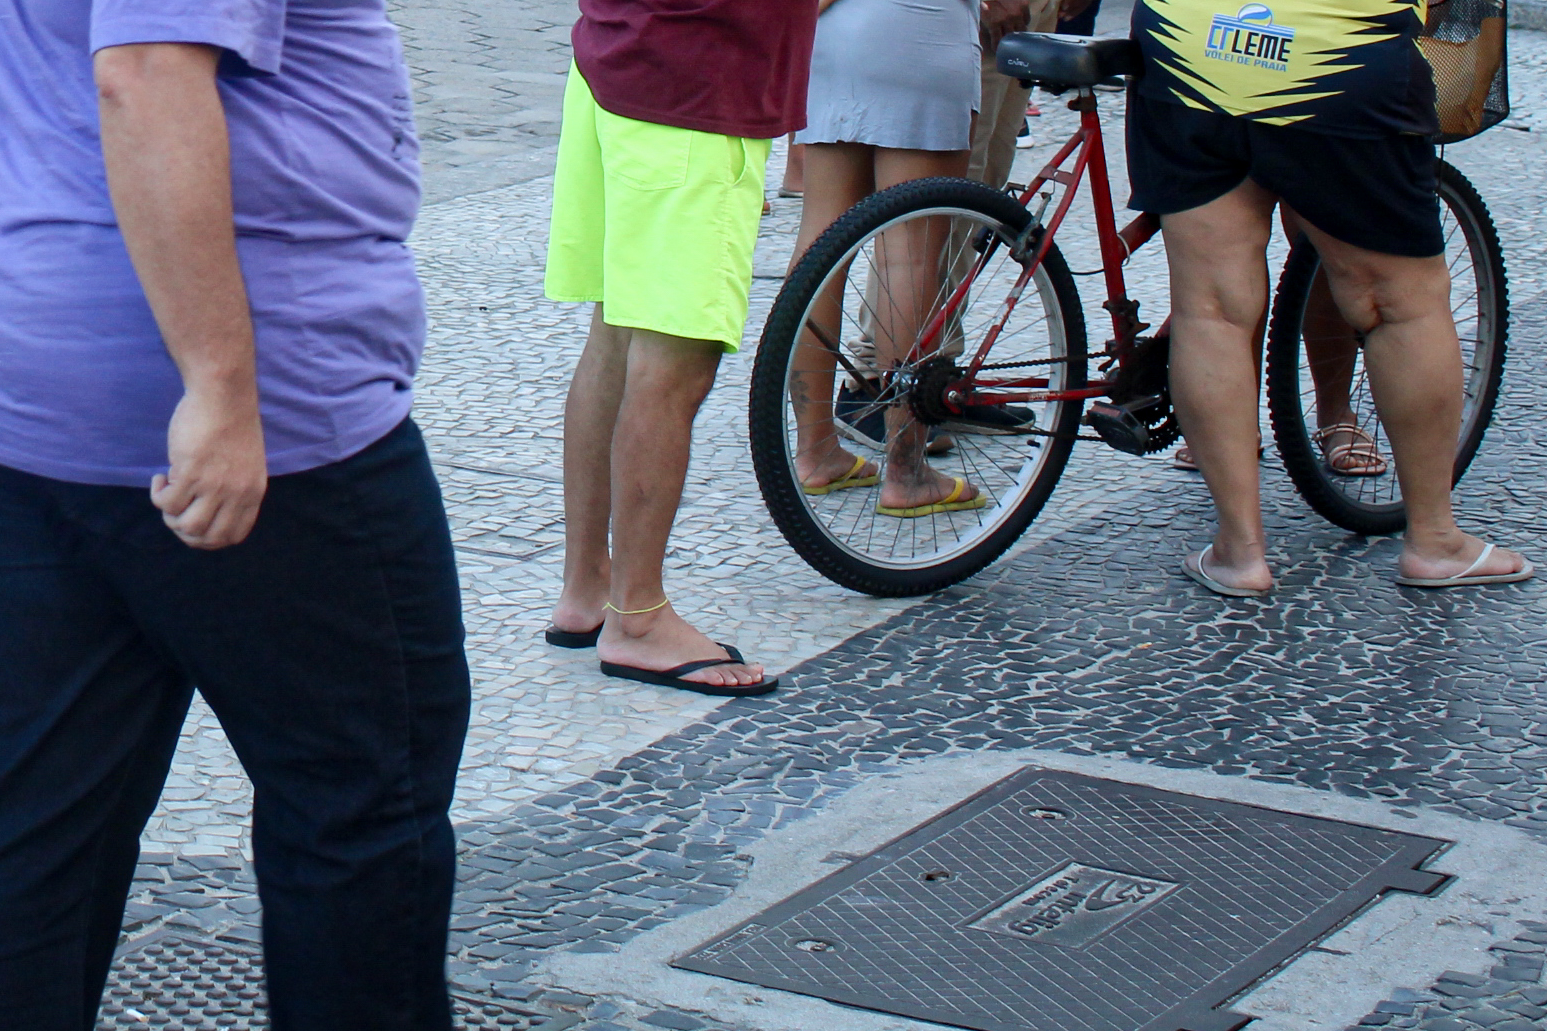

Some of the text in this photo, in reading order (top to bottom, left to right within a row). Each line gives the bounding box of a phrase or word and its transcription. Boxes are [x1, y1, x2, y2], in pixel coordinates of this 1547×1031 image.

[1237, 55, 1251, 66] DE
[1254, 58, 1287, 73] PRAIA
[1007, 890, 1088, 937] Intelig
